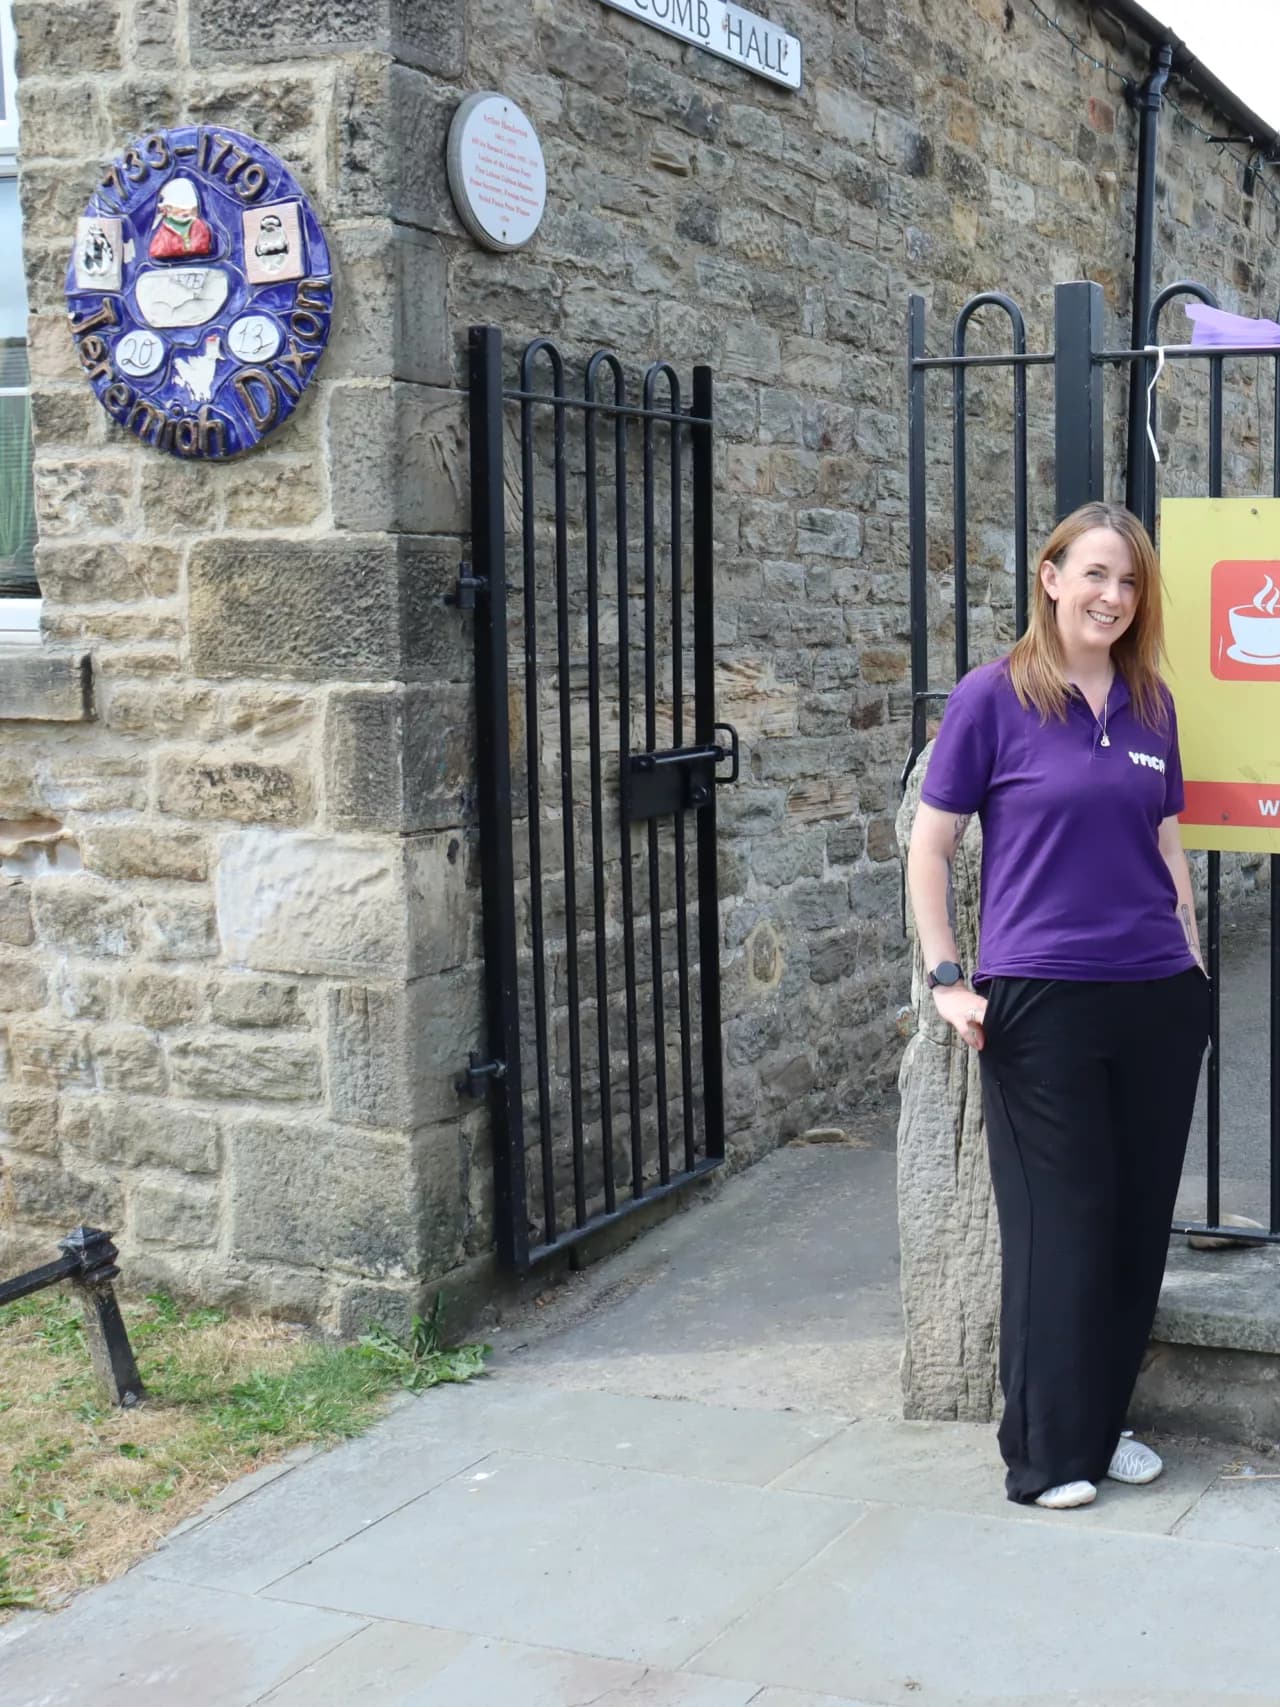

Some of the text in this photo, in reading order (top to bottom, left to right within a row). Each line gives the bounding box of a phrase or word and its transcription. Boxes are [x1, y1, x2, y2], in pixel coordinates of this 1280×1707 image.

[726, 12, 790, 76] HALL
[120, 338, 156, 370] 20
[234, 278, 330, 432] Dixon
